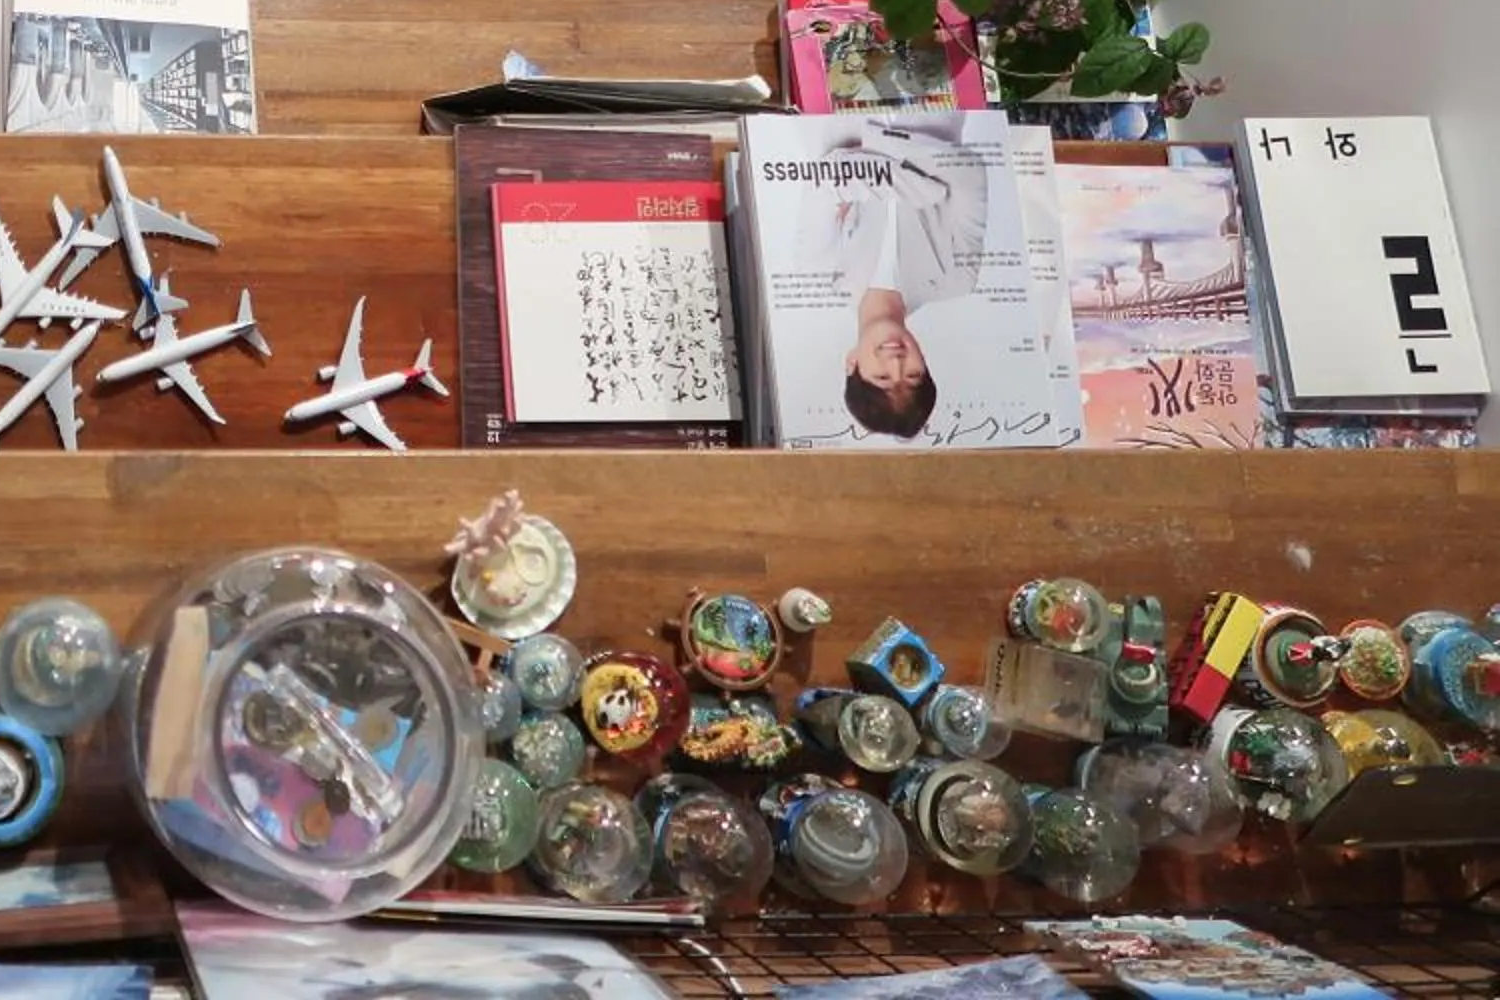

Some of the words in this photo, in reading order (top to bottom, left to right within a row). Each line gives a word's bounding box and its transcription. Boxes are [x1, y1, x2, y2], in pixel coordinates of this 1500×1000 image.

[1259, 127, 1292, 161] 나
[1324, 126, 1358, 161] 와
[762, 160, 894, 188] Mindfulness
